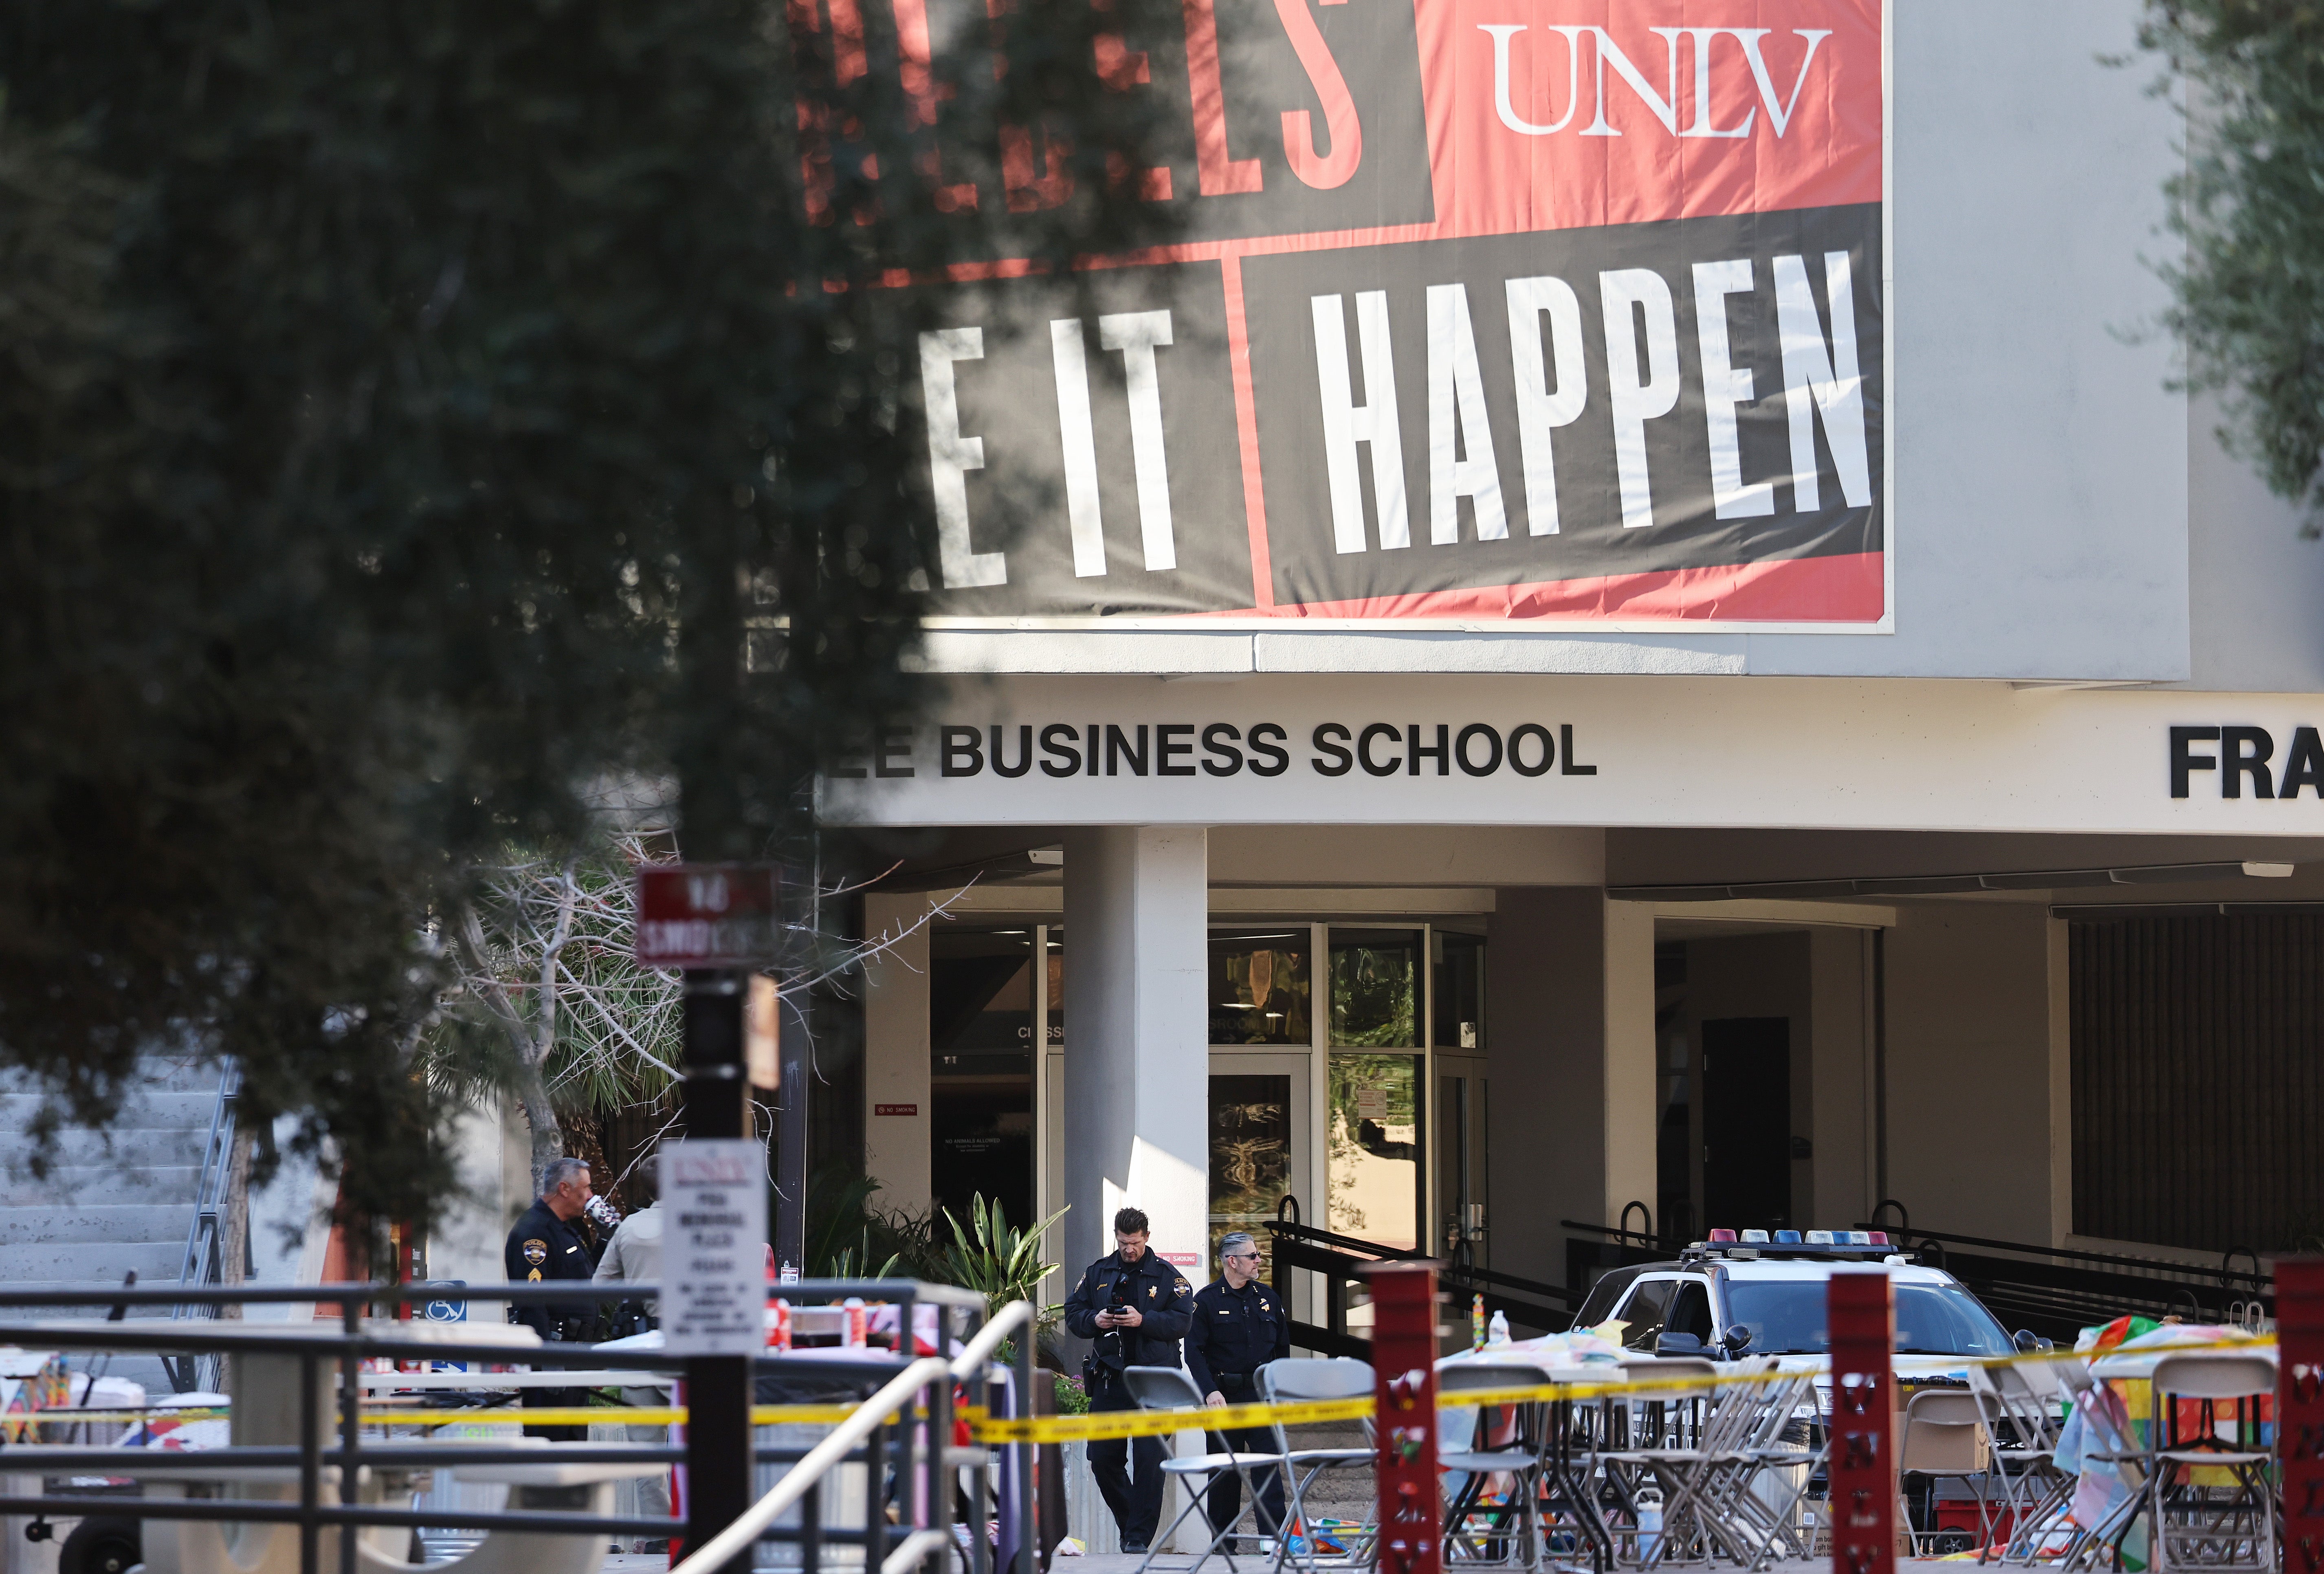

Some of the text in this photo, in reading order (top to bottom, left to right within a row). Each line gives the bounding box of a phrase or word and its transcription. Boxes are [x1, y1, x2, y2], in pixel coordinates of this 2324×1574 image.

[1476, 24, 1833, 139] UNLV
[1050, 309, 1176, 578] IT
[1311, 250, 1872, 555] HAPPEN
[941, 723, 1290, 778] BUSINESS
[1311, 723, 1597, 777] SCHOOL
[2170, 726, 2324, 799] FRA
